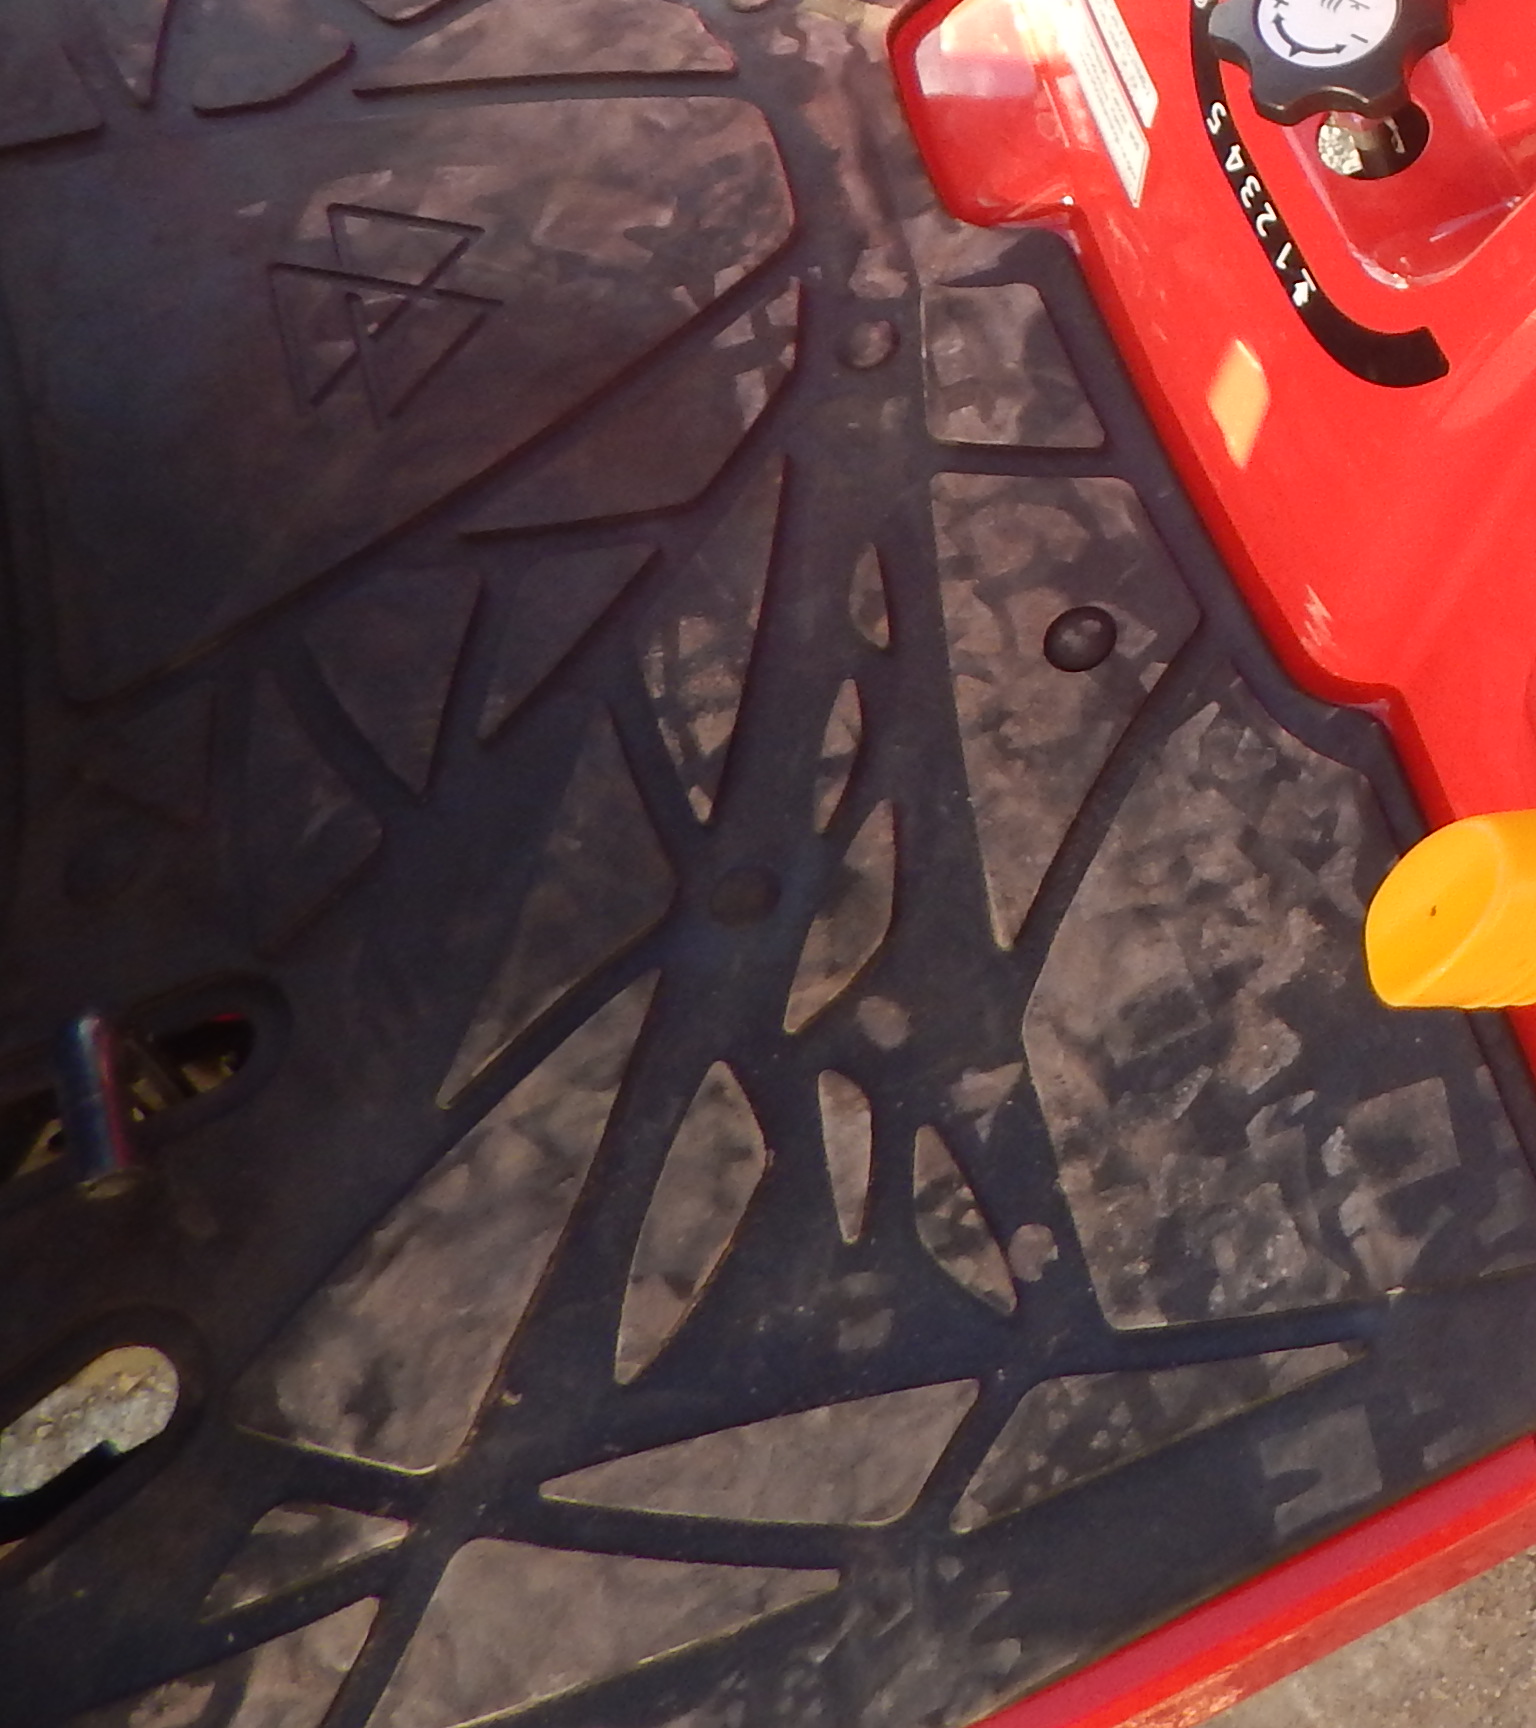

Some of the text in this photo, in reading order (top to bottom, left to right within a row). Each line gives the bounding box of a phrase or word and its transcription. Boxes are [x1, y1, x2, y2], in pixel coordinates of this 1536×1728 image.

[1206, 102, 1292, 270] 1 2 3 4 5
